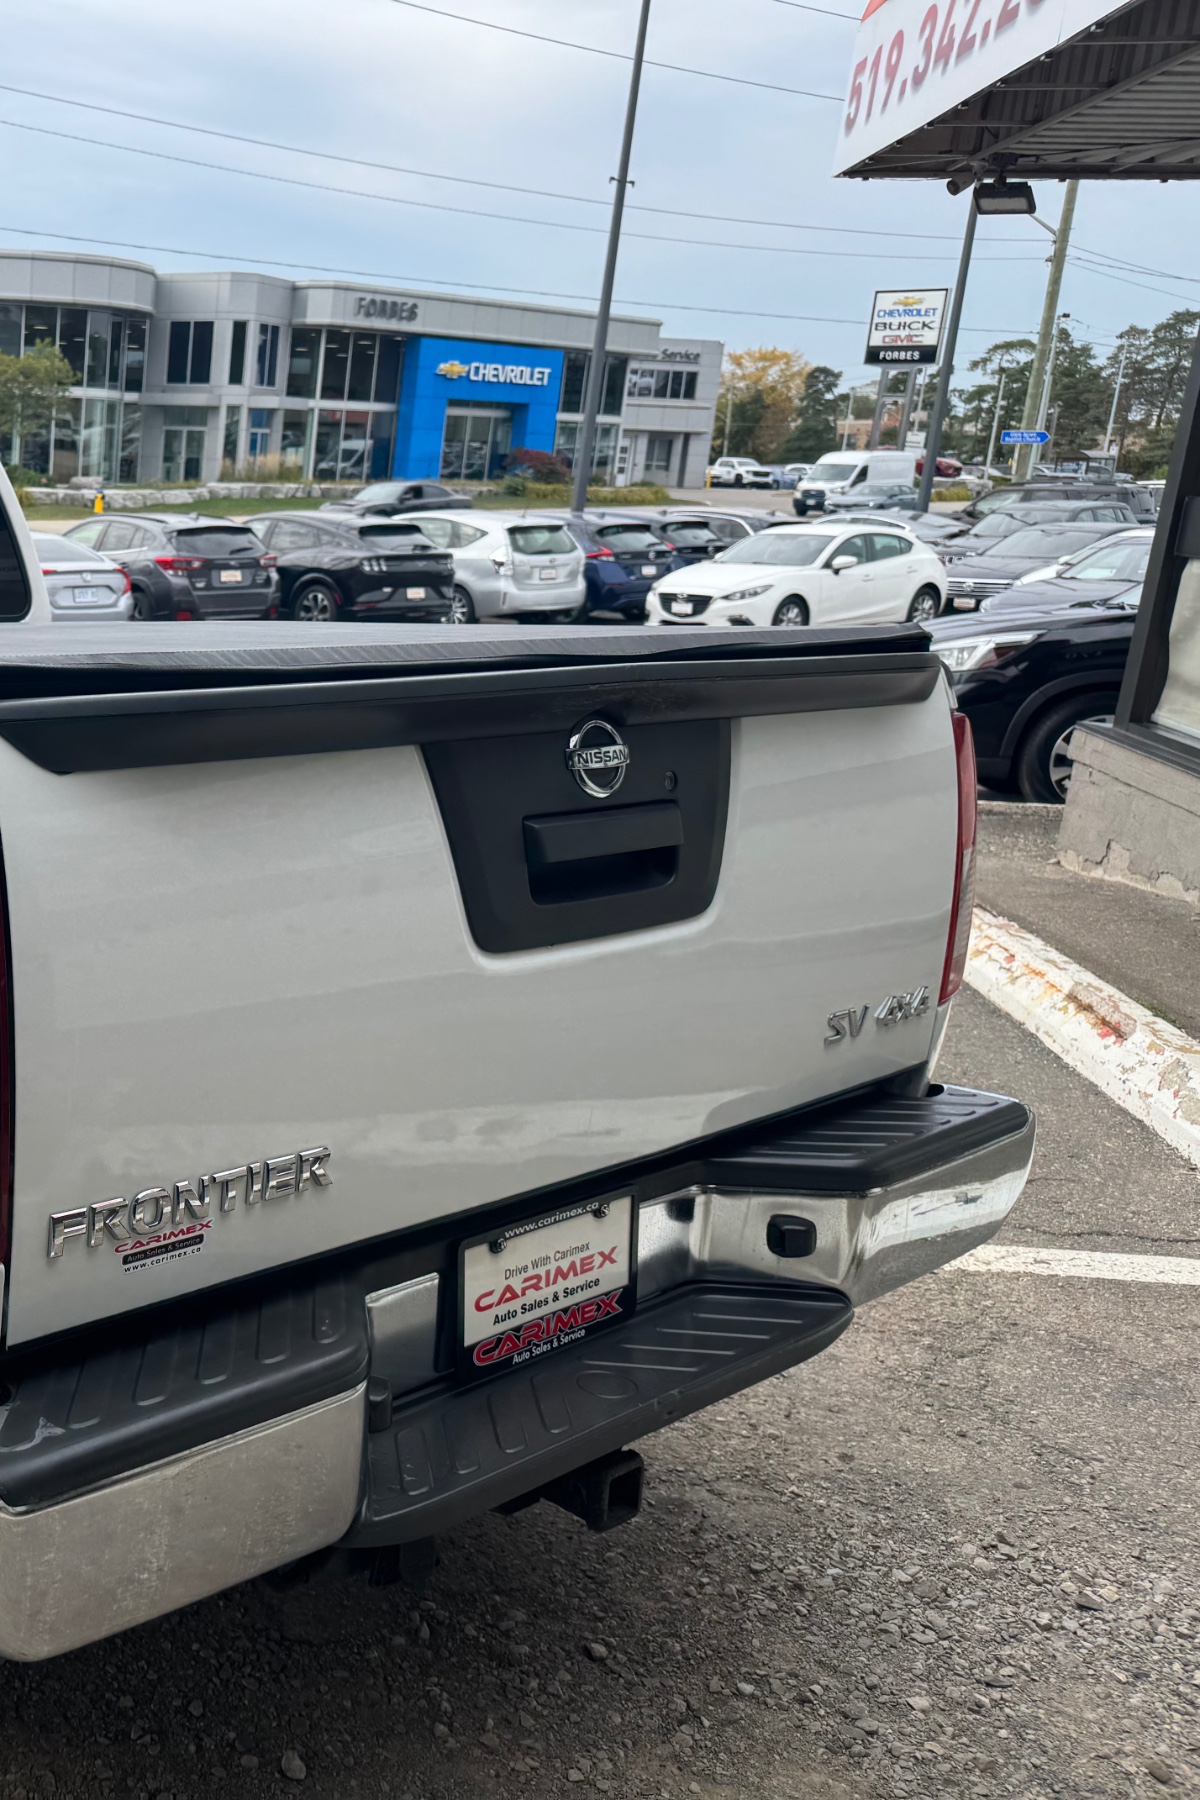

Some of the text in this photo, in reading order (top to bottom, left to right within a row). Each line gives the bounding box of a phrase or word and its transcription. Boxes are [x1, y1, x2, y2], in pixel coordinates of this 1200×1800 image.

[844, 0, 1046, 134] 519.342.
[354, 297, 419, 322] FORBES
[877, 308, 939, 319] CHEVROLET
[874, 321, 936, 331] BUICK
[882, 334, 925, 344] GMC
[661, 348, 701, 361] Service
[879, 351, 921, 361] FORBES
[469, 362, 552, 387] CHEVROLET
[577, 748, 627, 765] NISSAN
[824, 1003, 870, 1046] SV
[47, 1146, 334, 1259] FRONTIER
[504, 1201, 599, 1239] www.carimex.ca
[114, 1219, 213, 1254] CARIMEX
[126, 1253, 145, 1263] Auto
[146, 1248, 166, 1257] Sales
[175, 1237, 201, 1249] Service
[124, 1246, 201, 1273] www.carimex.ca
[504, 1241, 591, 1281] Drive With Carimex
[474, 1245, 618, 1313] CARIMEX
[492, 1277, 601, 1326] Auto Sales & Service
[473, 1289, 624, 1366] CARIMEX
[512, 1328, 586, 1365] Auto Sales & Service
